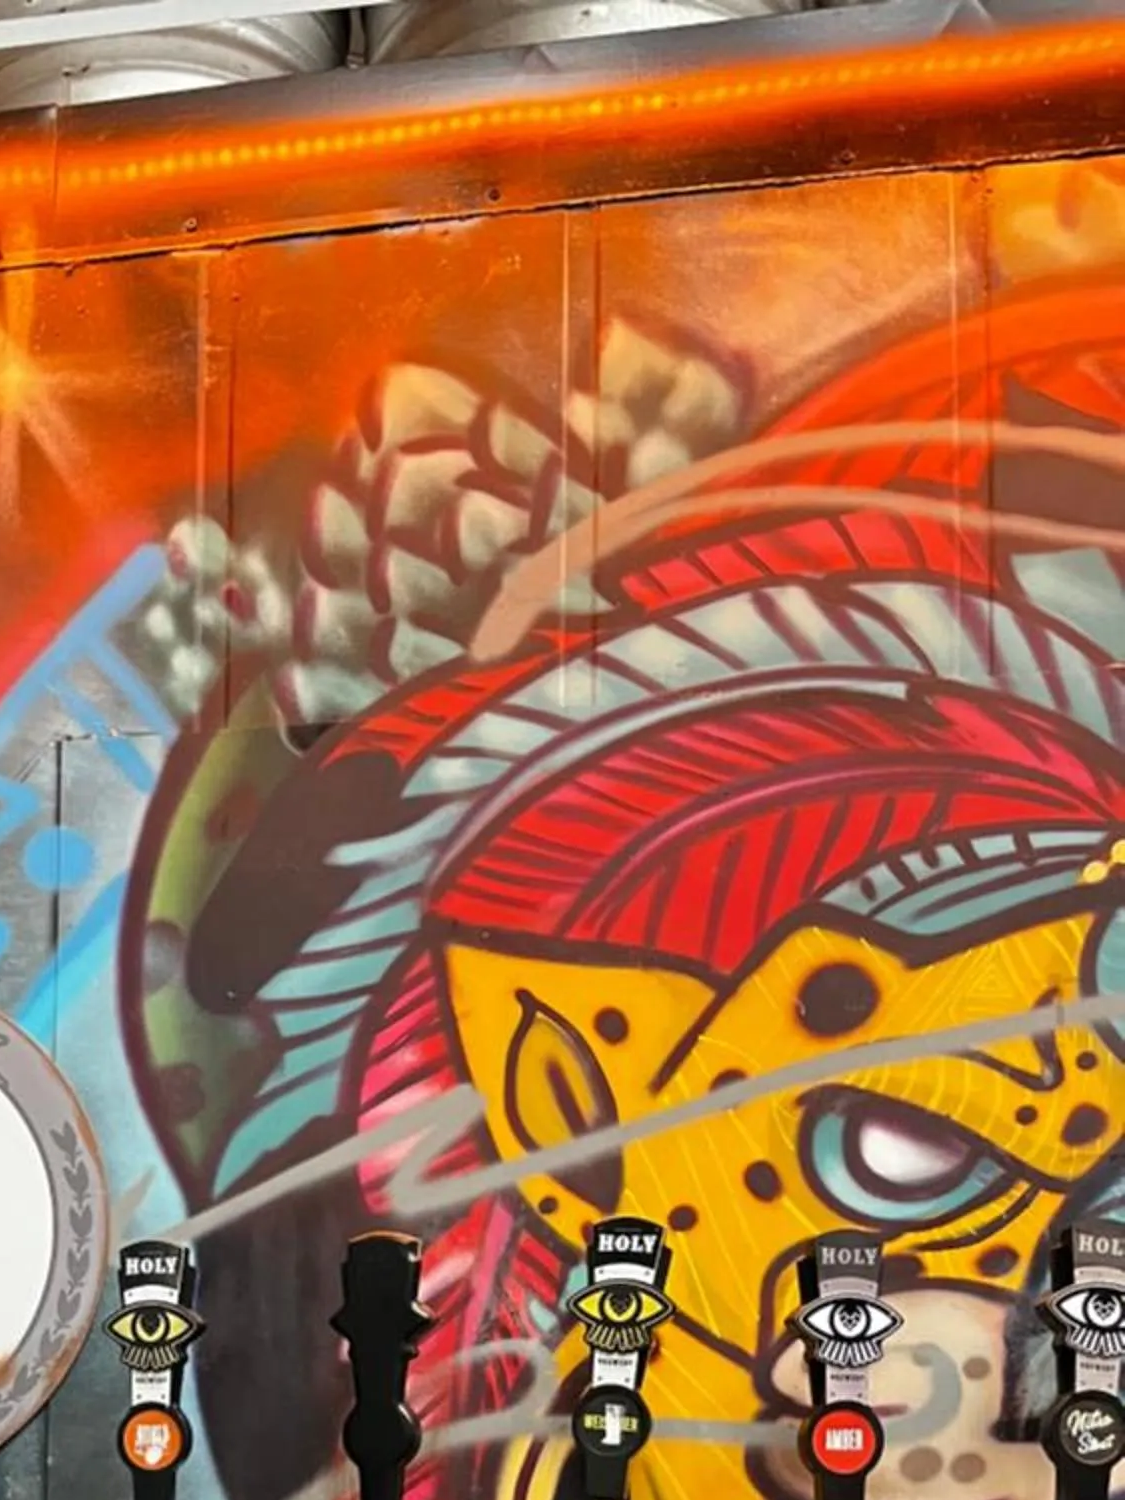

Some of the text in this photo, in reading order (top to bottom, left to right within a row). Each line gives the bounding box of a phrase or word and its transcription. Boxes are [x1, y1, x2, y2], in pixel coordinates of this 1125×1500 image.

[598, 1233, 657, 1255] HOLY
[125, 1255, 178, 1277] HOLY
[821, 1247, 878, 1266] HOLY
